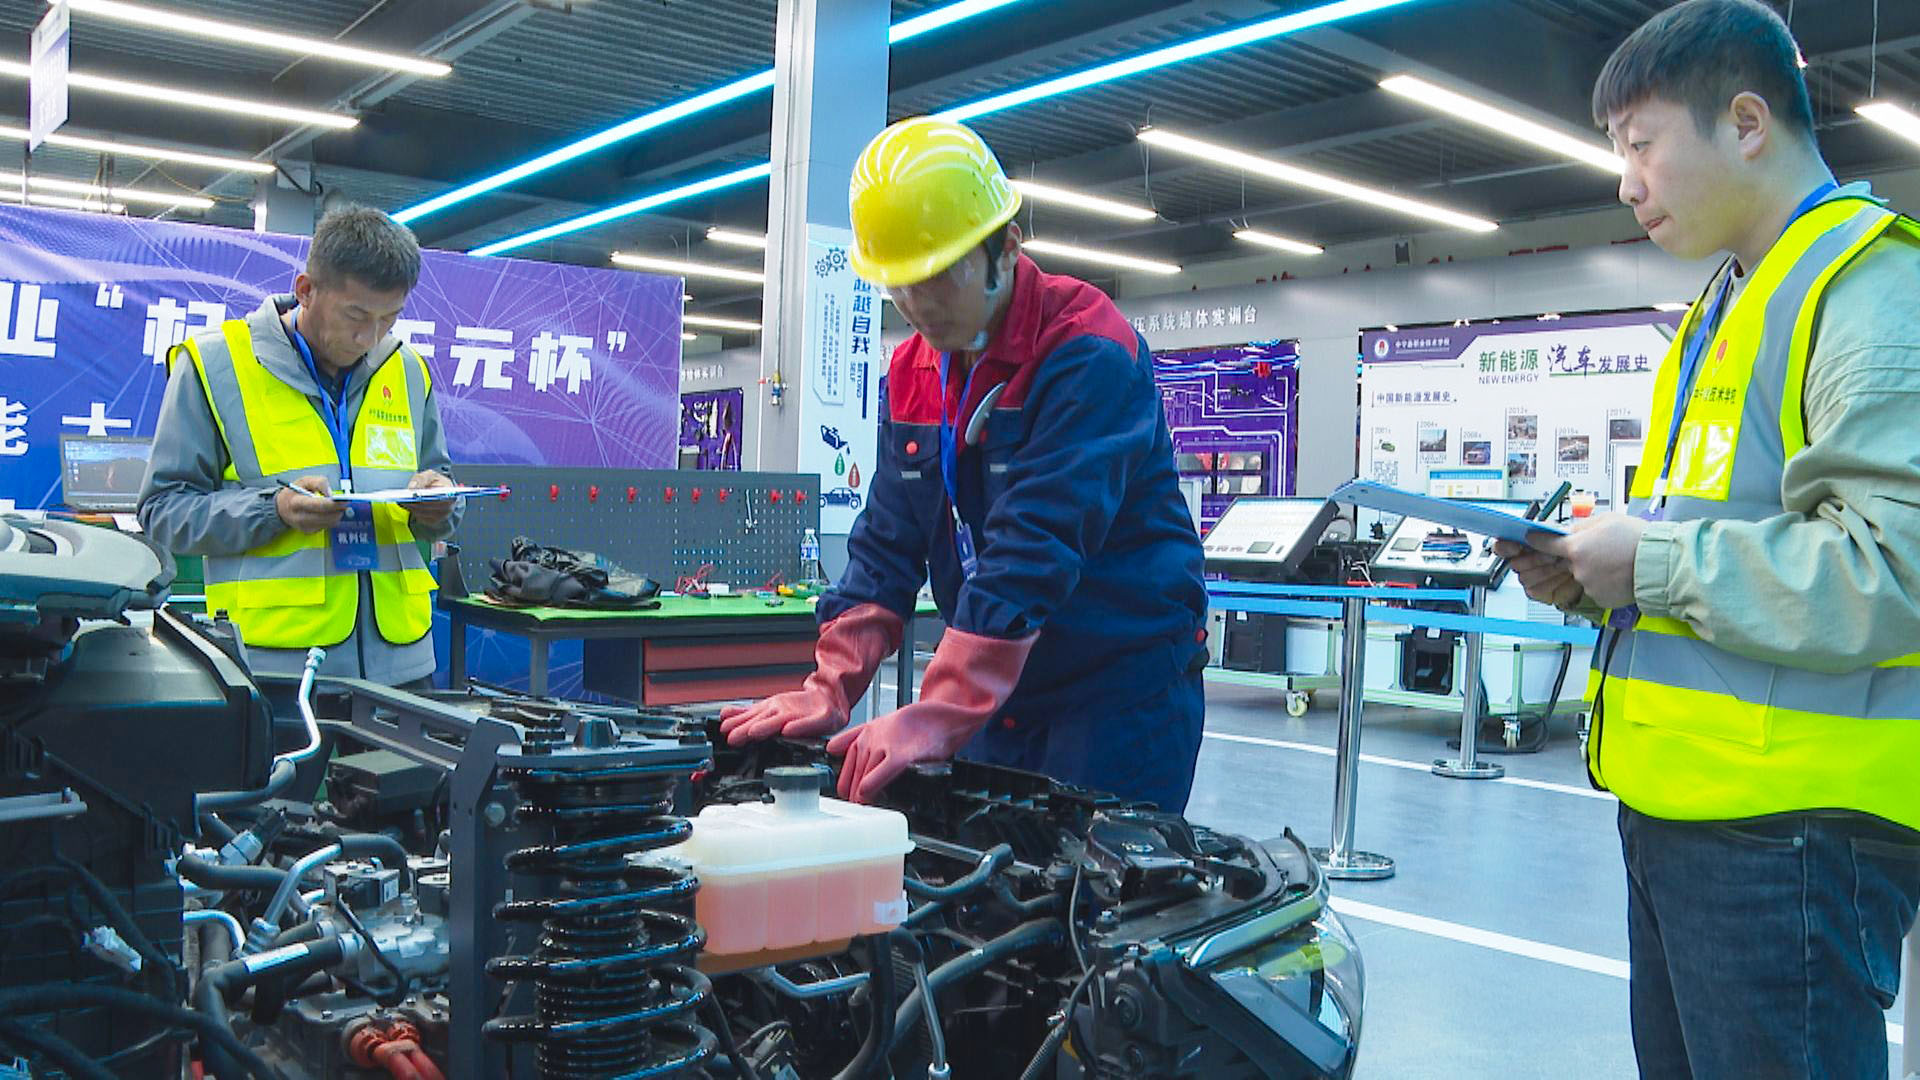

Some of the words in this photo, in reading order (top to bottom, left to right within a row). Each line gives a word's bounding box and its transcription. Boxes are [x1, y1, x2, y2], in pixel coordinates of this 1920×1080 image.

[1127, 304, 1257, 332] 压系统墙体实训台
[1478, 375, 1499, 385] NEW
[1501, 373, 1539, 384] ENERGY
